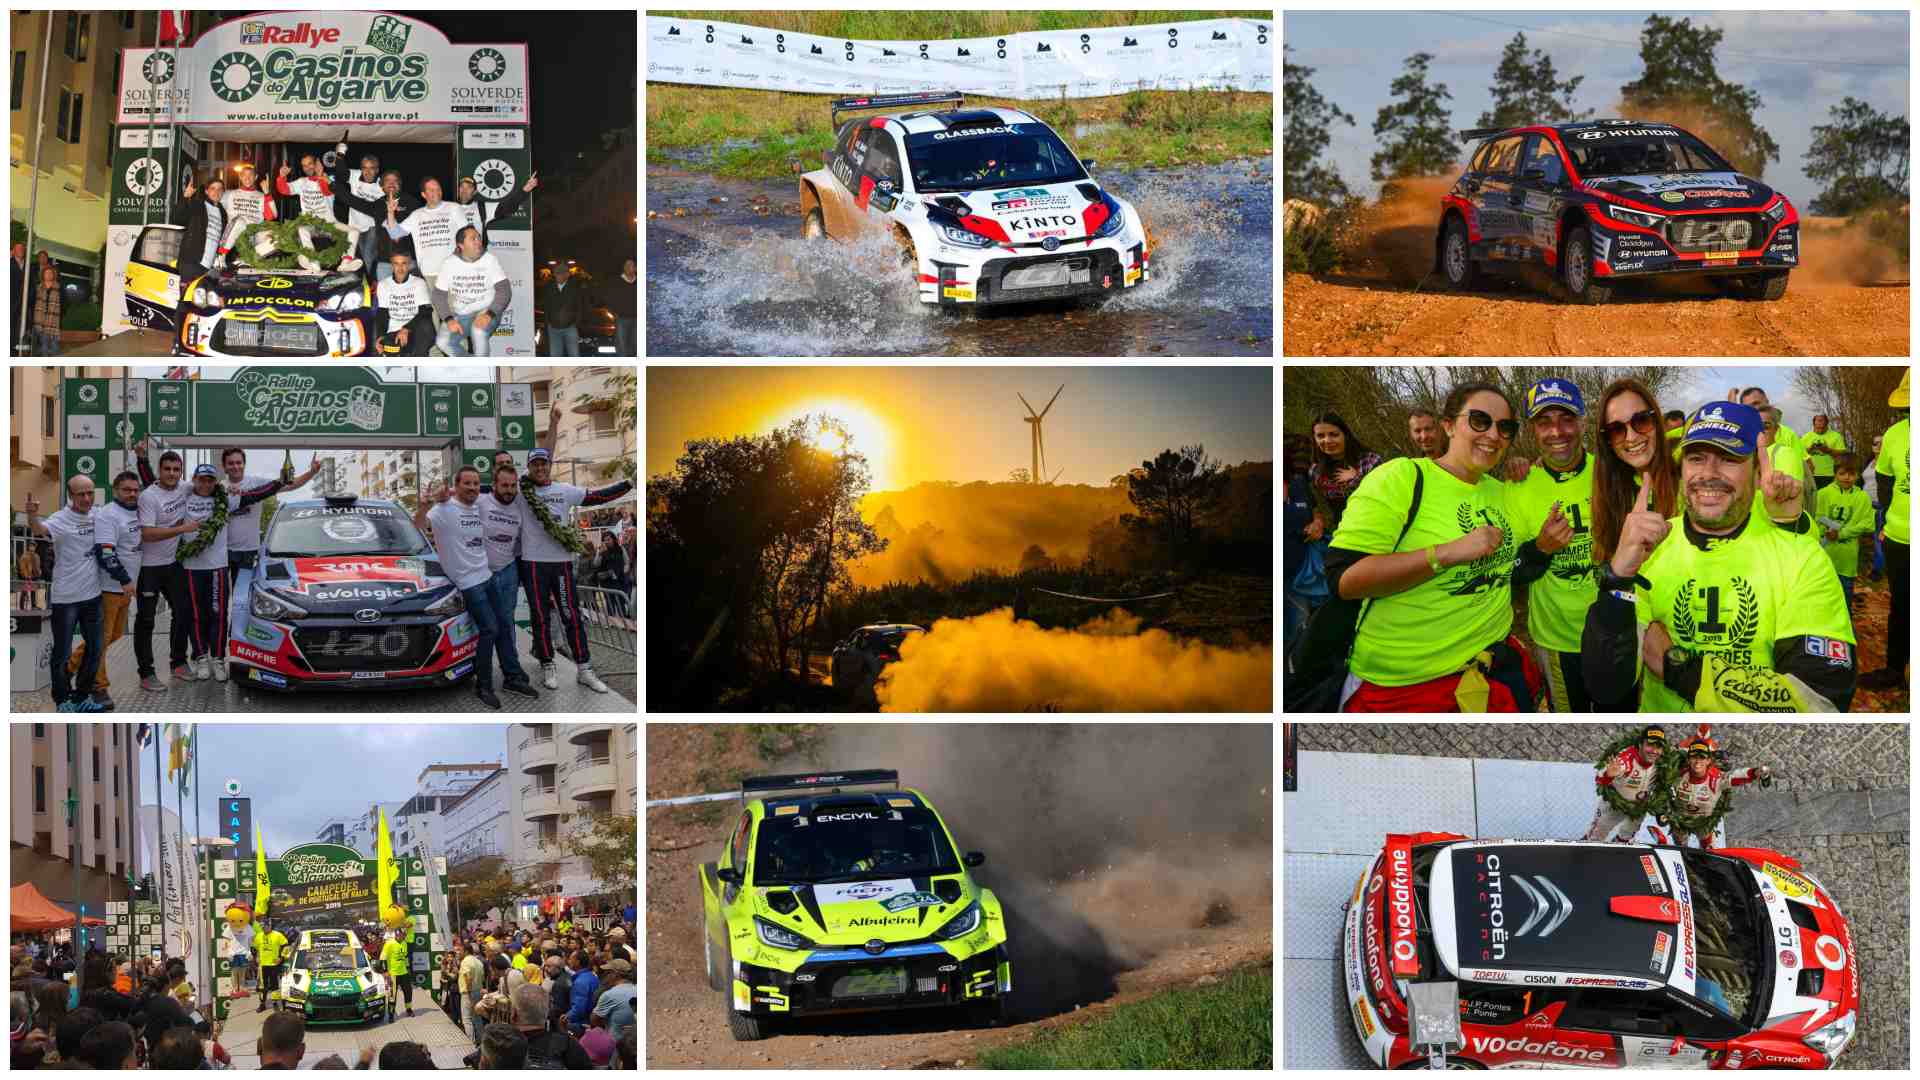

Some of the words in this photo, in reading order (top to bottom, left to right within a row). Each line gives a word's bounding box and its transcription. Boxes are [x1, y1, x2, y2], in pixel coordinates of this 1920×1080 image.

[262, 23, 340, 48] Rallye
[266, 49, 425, 79] Casinos
[266, 81, 283, 93] do
[280, 76, 426, 107] Algarve
[451, 87, 523, 99] SOLVERDE
[227, 111, 420, 122] www.clubeautomovelalgarve.pt
[933, 125, 1016, 140] GLASSBACK
[1608, 129, 1680, 139] HYUNDAI
[1633, 249, 1668, 257] HYUNDAI
[227, 296, 315, 308] IMPOCOLOR
[269, 376, 315, 392] Rallye
[251, 388, 350, 409] Casinos
[259, 406, 348, 430] Algarve
[1688, 421, 1741, 435] MICHELIN
[322, 507, 392, 517] HYUNDAI
[1566, 503, 1590, 534] 1
[316, 585, 403, 602] evologic
[1698, 586, 1727, 633] 1
[237, 647, 277, 665] MAPFRE
[817, 812, 879, 823] ENCIVIL
[296, 855, 327, 864] Rallye
[290, 863, 345, 875] Casinos
[307, 880, 359, 897] CAMPEÕES
[836, 886, 895, 896] FUCHS
[1390, 850, 1415, 930] vodafone
[299, 896, 308, 905] DE
[308, 893, 341, 904] PORTUGAL
[1477, 853, 1490, 960] RACING
[1486, 854, 1510, 960] CITROËN
[848, 915, 916, 927] Albufeira
[1780, 927, 1792, 948] LG
[1364, 900, 1387, 991] vodafone
[1472, 970, 1507, 979] TOPTUL
[1524, 975, 1556, 985] CISION
[1484, 1001, 1512, 1012] Fontes
[1522, 992, 1532, 1015] 1
[1472, 1036, 1606, 1061] vodafone
[1766, 1054, 1811, 1064] CITROËN
